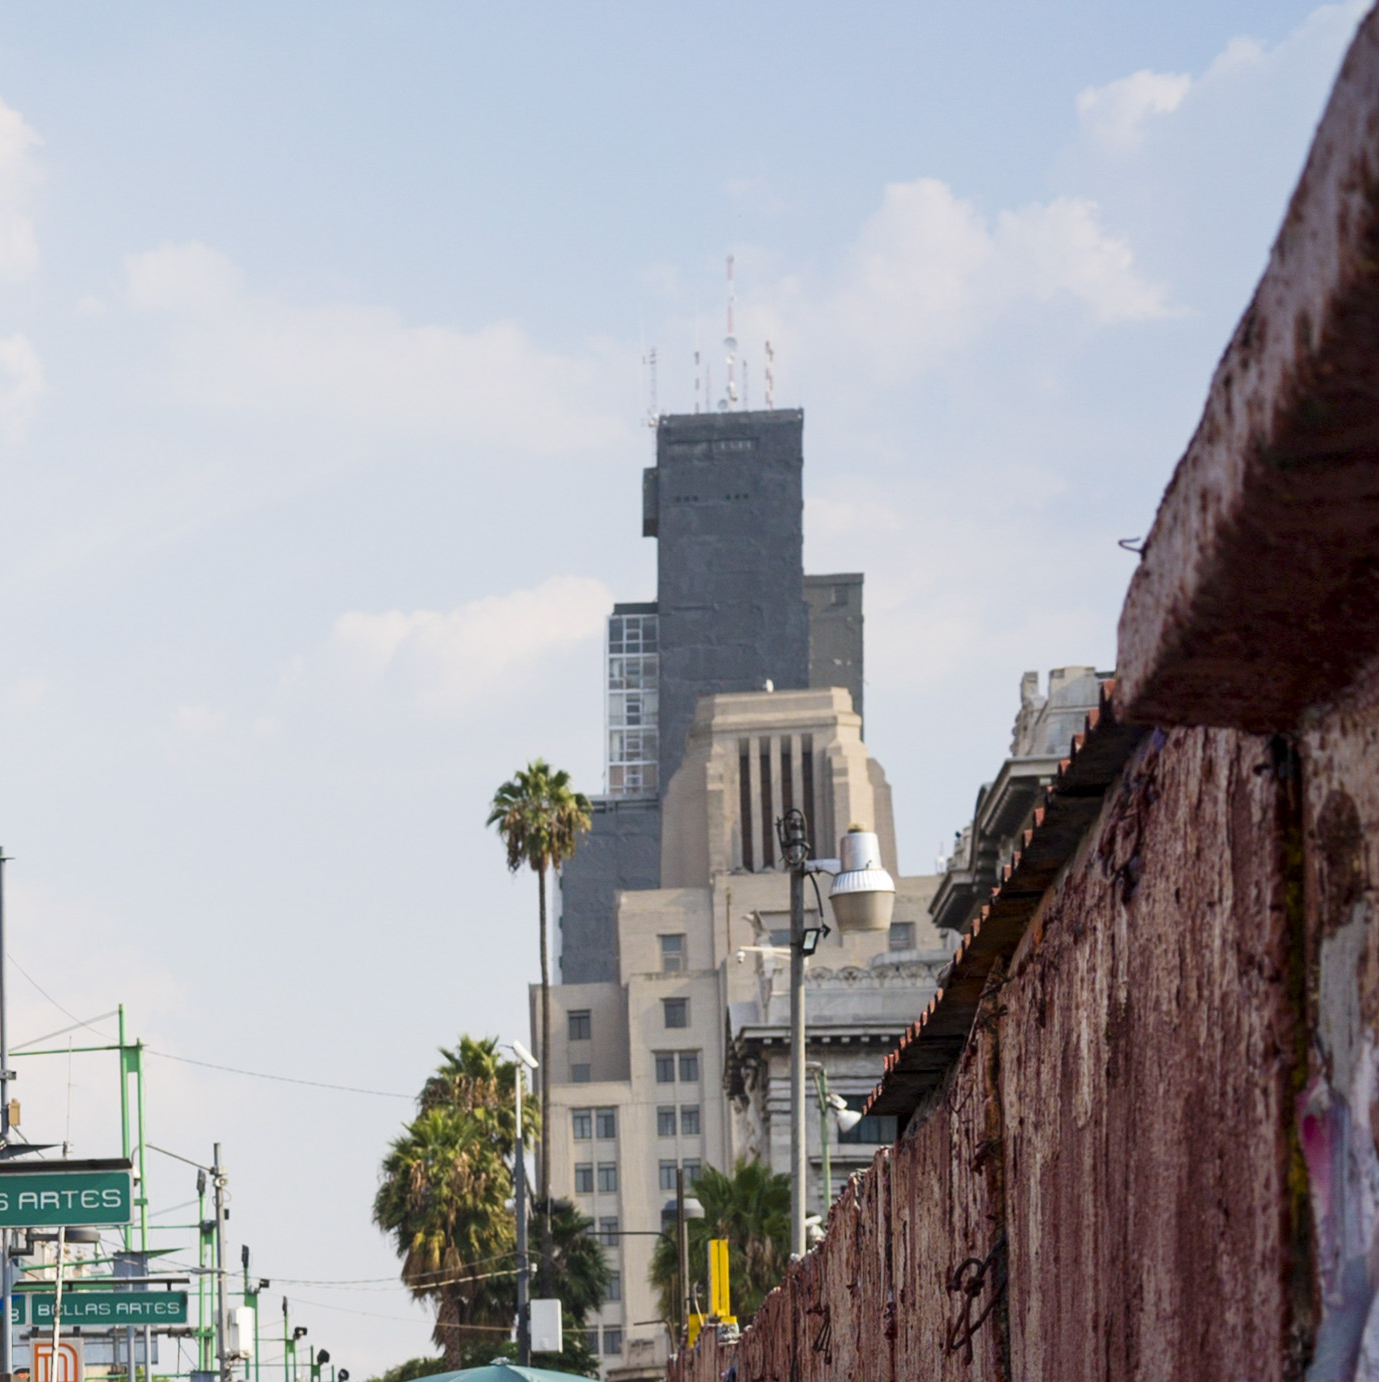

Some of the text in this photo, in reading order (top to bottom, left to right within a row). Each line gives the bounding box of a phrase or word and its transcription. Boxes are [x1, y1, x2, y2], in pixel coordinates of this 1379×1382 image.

[18, 1189, 122, 1211] ARTES
[38, 1302, 180, 1316] BELLAS ARTES
